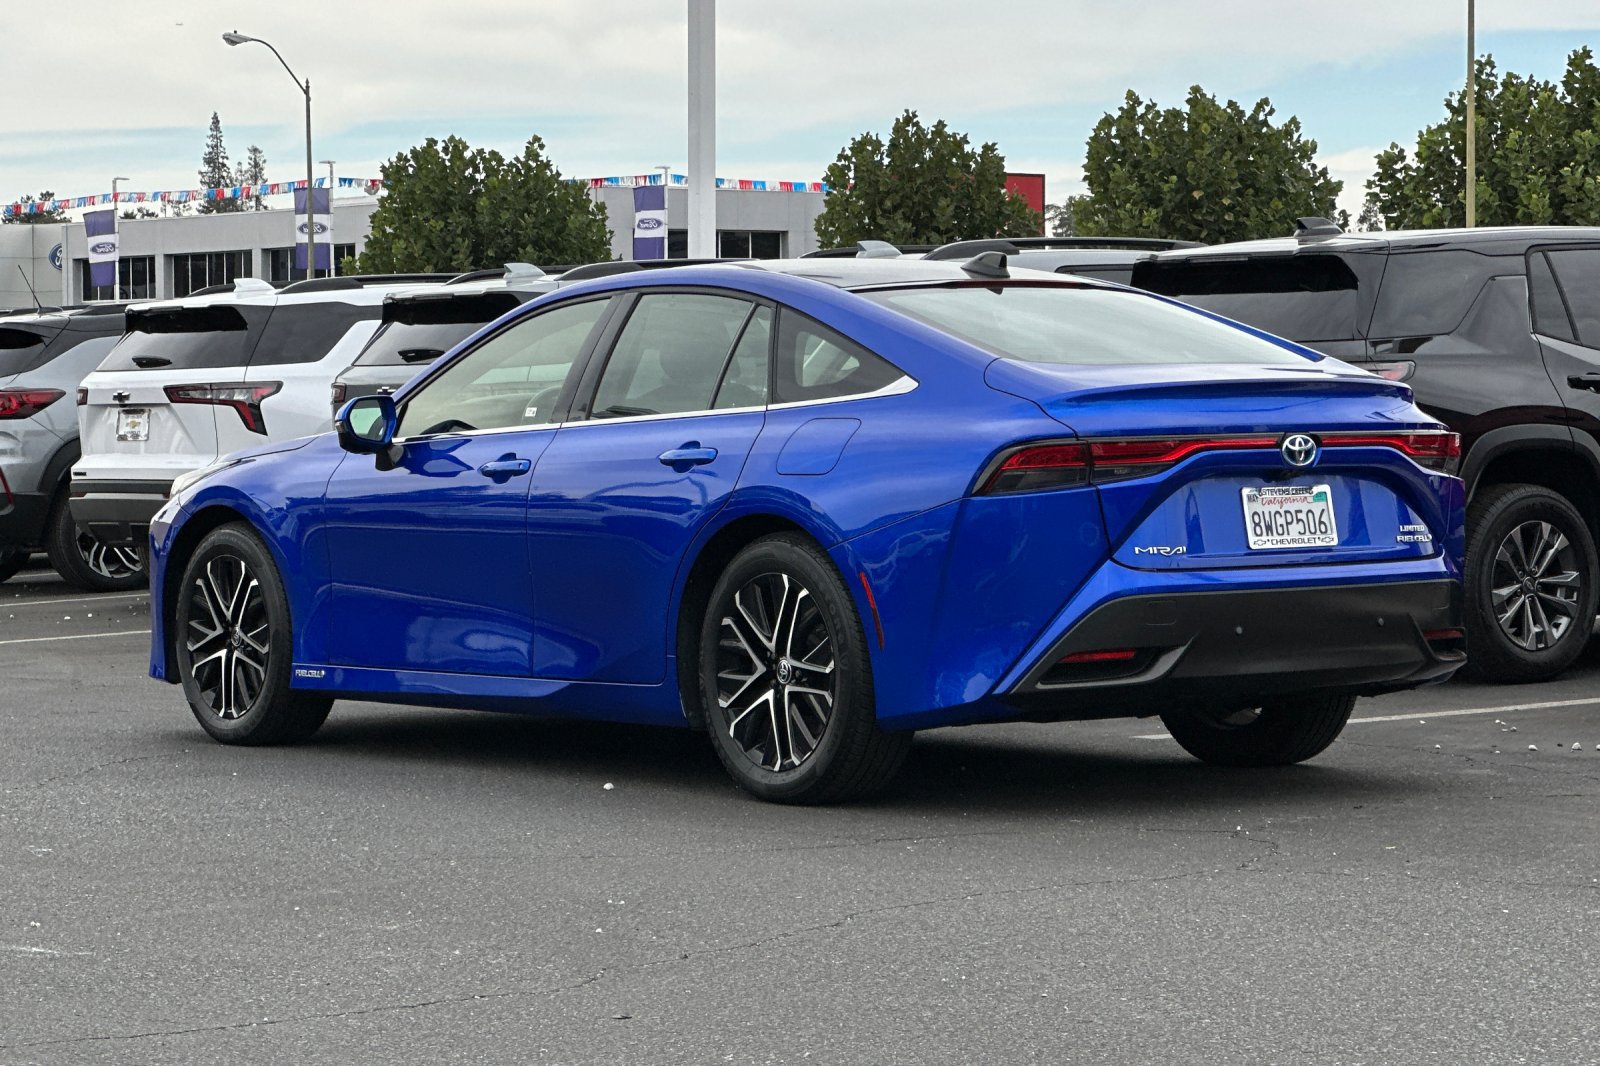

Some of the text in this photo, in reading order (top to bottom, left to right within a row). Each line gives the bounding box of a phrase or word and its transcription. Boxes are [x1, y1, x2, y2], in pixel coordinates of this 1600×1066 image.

[1262, 487, 1290, 496] STEVENS
[1261, 496, 1309, 509] California
[1252, 508, 1328, 537] 8WGP506
[1399, 524, 1425, 532] LIMITED
[1270, 537, 1316, 545] CHEVROLET
[1134, 546, 1187, 556] MIRAI
